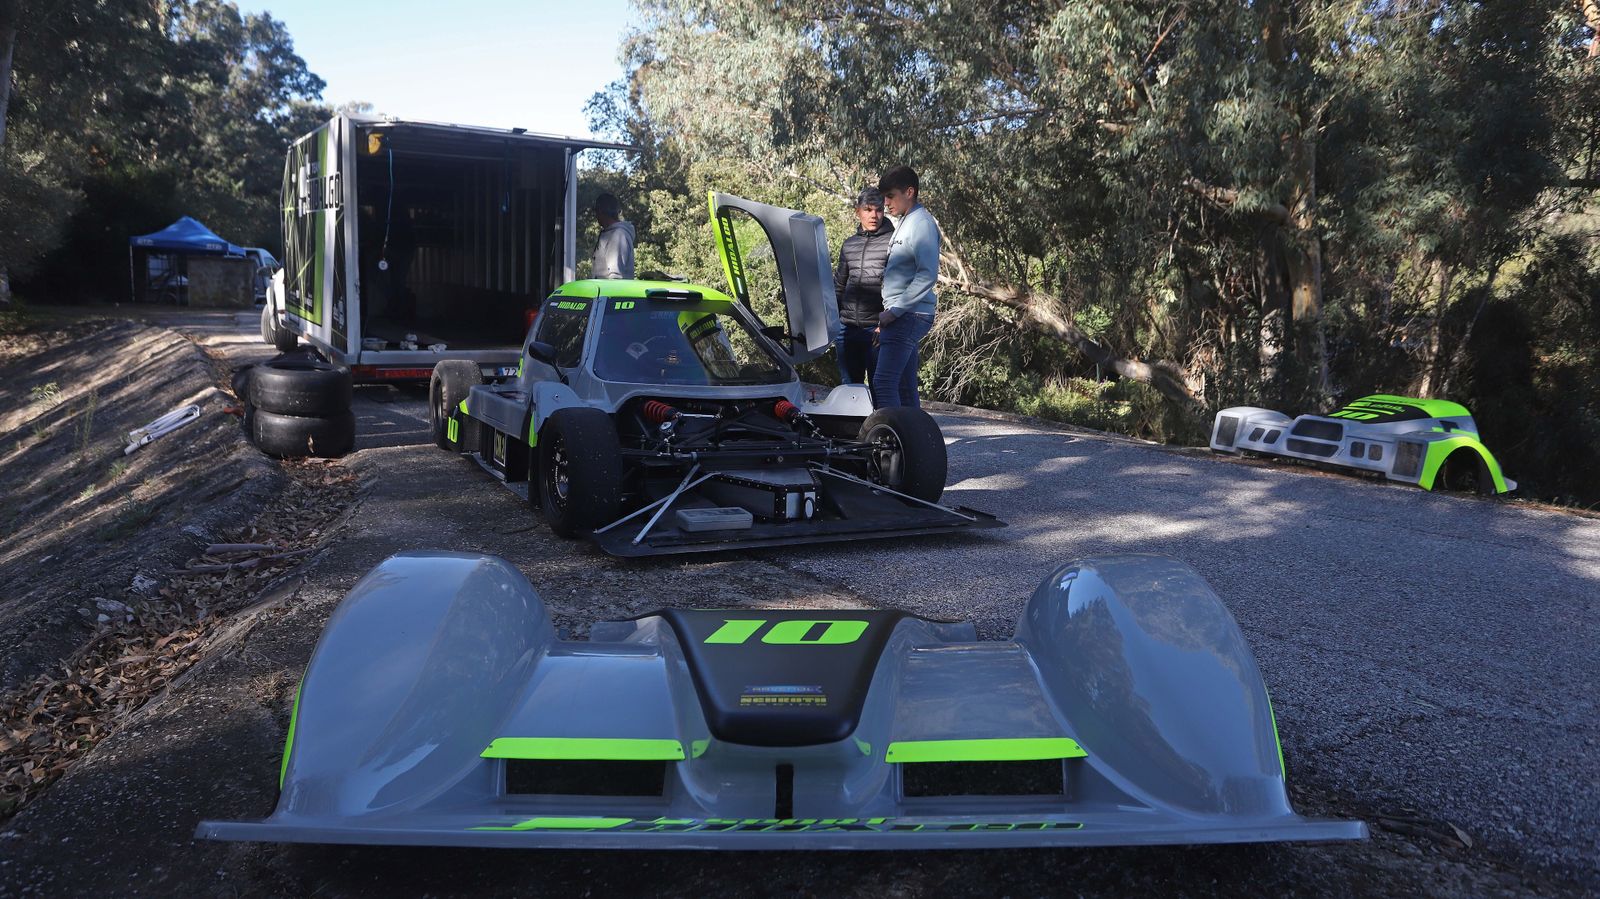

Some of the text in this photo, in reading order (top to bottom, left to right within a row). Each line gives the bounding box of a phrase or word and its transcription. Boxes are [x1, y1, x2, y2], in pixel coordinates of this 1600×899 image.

[722, 216, 740, 276] HIDALGO
[557, 301, 587, 310] HIDALGO
[614, 302, 635, 310] 10
[447, 416, 459, 443] 10
[704, 620, 870, 644] 10
